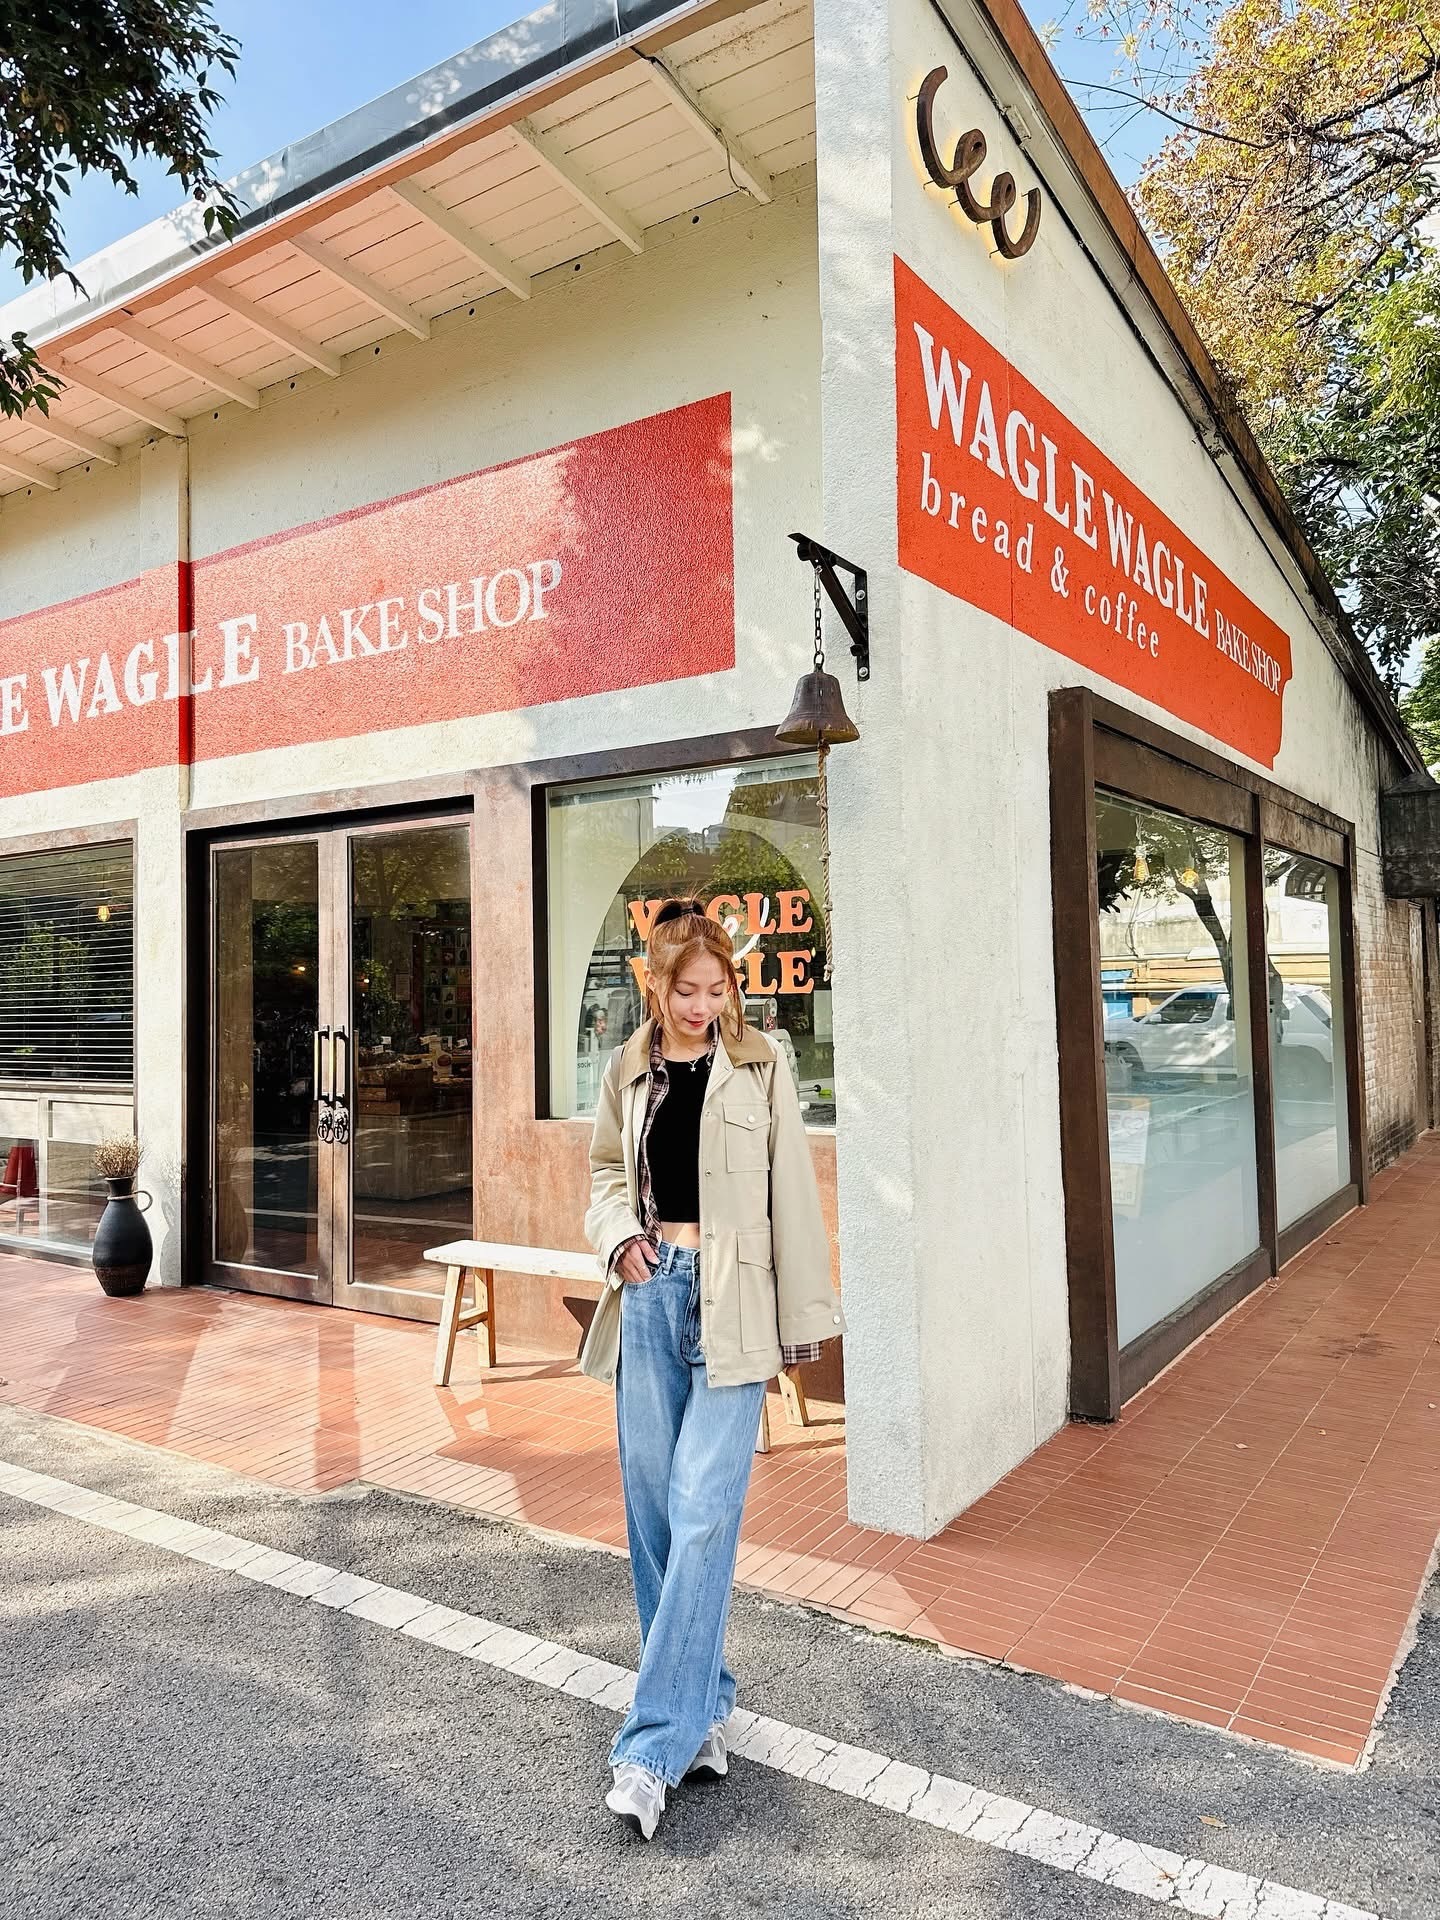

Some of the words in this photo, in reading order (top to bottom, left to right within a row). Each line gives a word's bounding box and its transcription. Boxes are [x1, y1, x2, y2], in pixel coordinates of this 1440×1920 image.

[913, 321, 1098, 550] WAGLE
[1102, 491, 1210, 640] WAGLE
[1215, 608, 1250, 673] BAKE
[1252, 641, 1281, 696] SHOP
[921, 452, 1034, 574] bread
[1051, 546, 1070, 599] &
[1084, 584, 1160, 659] coffee
[41, 613, 261, 728] WAGLE
[283, 599, 410, 676] BAKE
[416, 558, 562, 646] SHOP
[628, 889, 813, 942] WGLE
